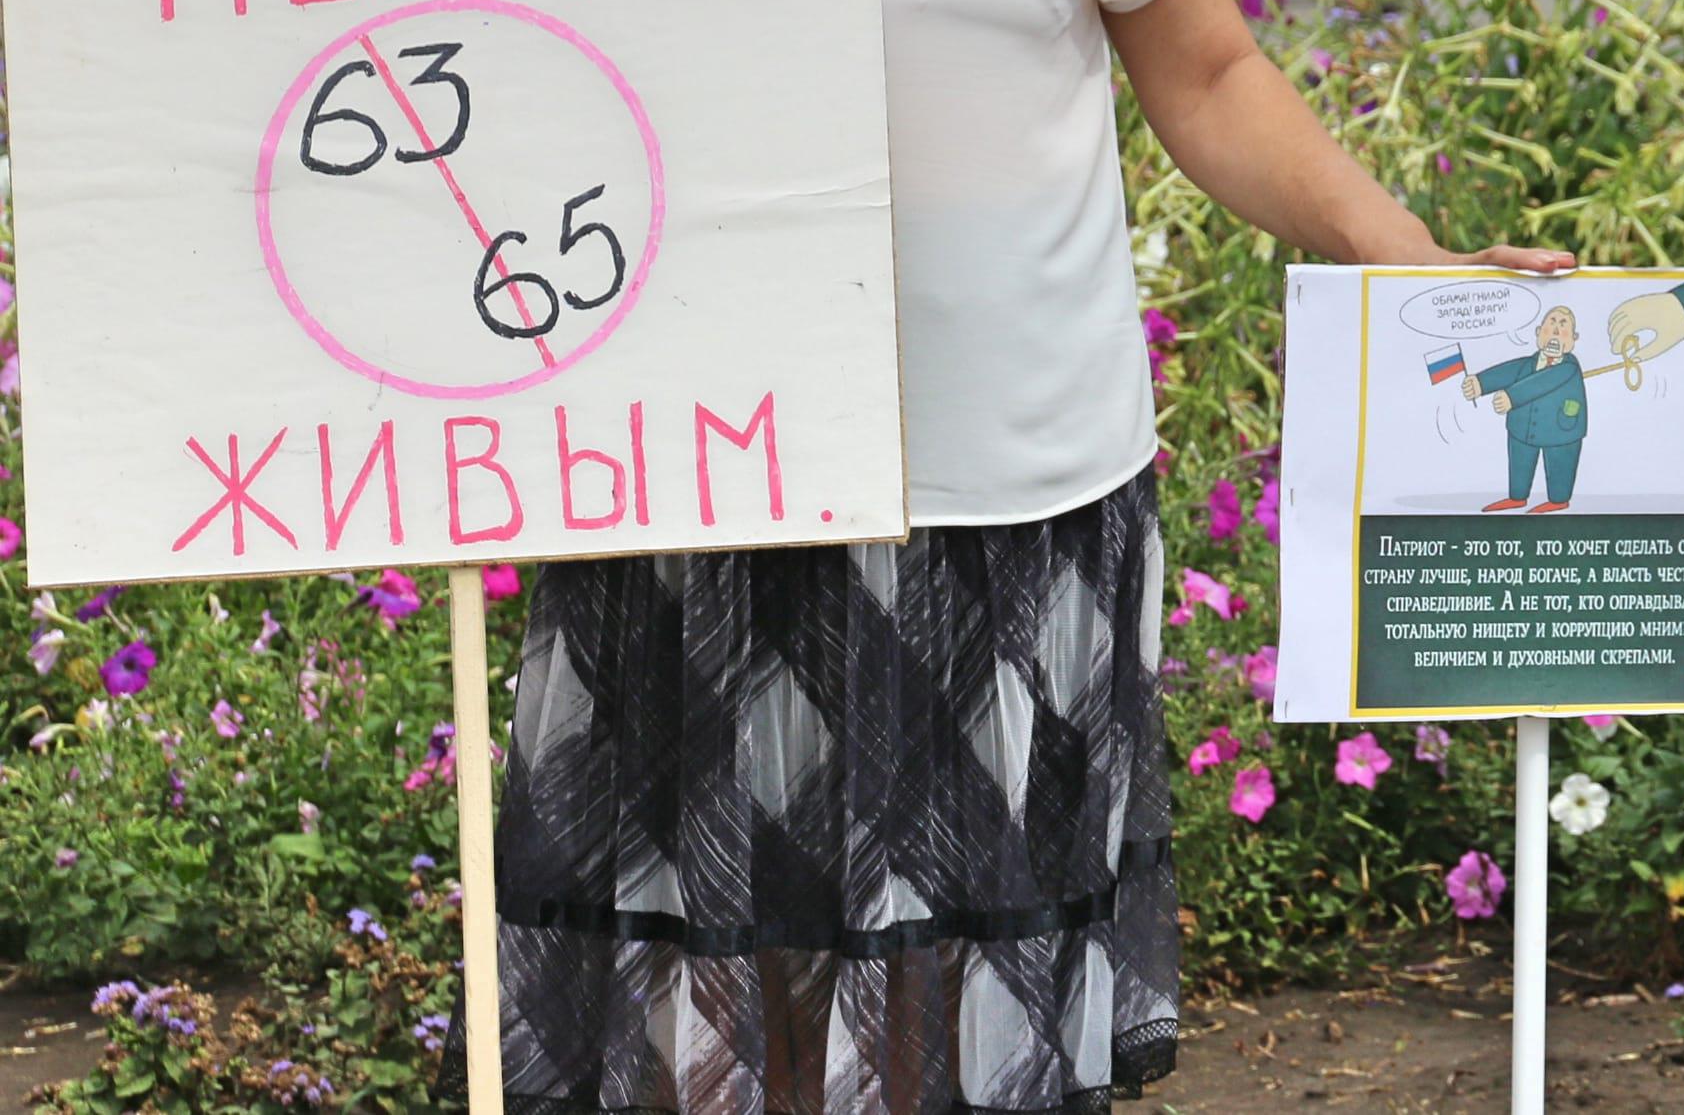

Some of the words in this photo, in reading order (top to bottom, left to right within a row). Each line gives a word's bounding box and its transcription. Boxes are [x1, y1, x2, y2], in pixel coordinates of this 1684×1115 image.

[302, 44, 470, 175] 63
[474, 185, 625, 339] 65
[1432, 293, 1470, 306] ОБАМА!
[1472, 288, 1510, 302] ГНИЛОЙ
[1451, 317, 1496, 330] РОССИЯ!
[172, 391, 835, 556] ЖИВЫМ.
[1464, 541, 1490, 556] ЭТО
[1495, 540, 1525, 558] ТОТ,
[1535, 540, 1562, 555] КТО
[1567, 539, 1610, 555] ХОЧЕТ
[1615, 539, 1673, 557] СДЕЛАТЬ
[1364, 569, 1415, 584] СТРАНУ
[1419, 568, 1472, 586] ЛУЧШЕ,
[1477, 568, 1523, 586] НАРОД
[1528, 567, 1581, 585] БОГАЧЕ,
[1586, 567, 1597, 583] А
[1602, 567, 1652, 583] ВЛАСТЬ
[1386, 596, 1495, 614] СПРАВЕДЛИВИЕ.
[1500, 590, 1514, 611] А
[1520, 595, 1539, 611] НЕ
[1543, 595, 1572, 613] ТОТ,
[1578, 595, 1604, 610] КТО
[1384, 623, 1467, 639] ТОТАЛЬНУЮ
[1472, 622, 1530, 641] НИЩЕТУ
[1535, 622, 1545, 638] И
[1551, 621, 1634, 640] КОРРУПЦИЮ
[1414, 651, 1487, 667] ВЕЛИЧИЕМ
[1493, 651, 1503, 666] И
[1507, 650, 1595, 668] ДУХОВНЫМИ
[1600, 649, 1676, 664] СКРЕПАМИ.
